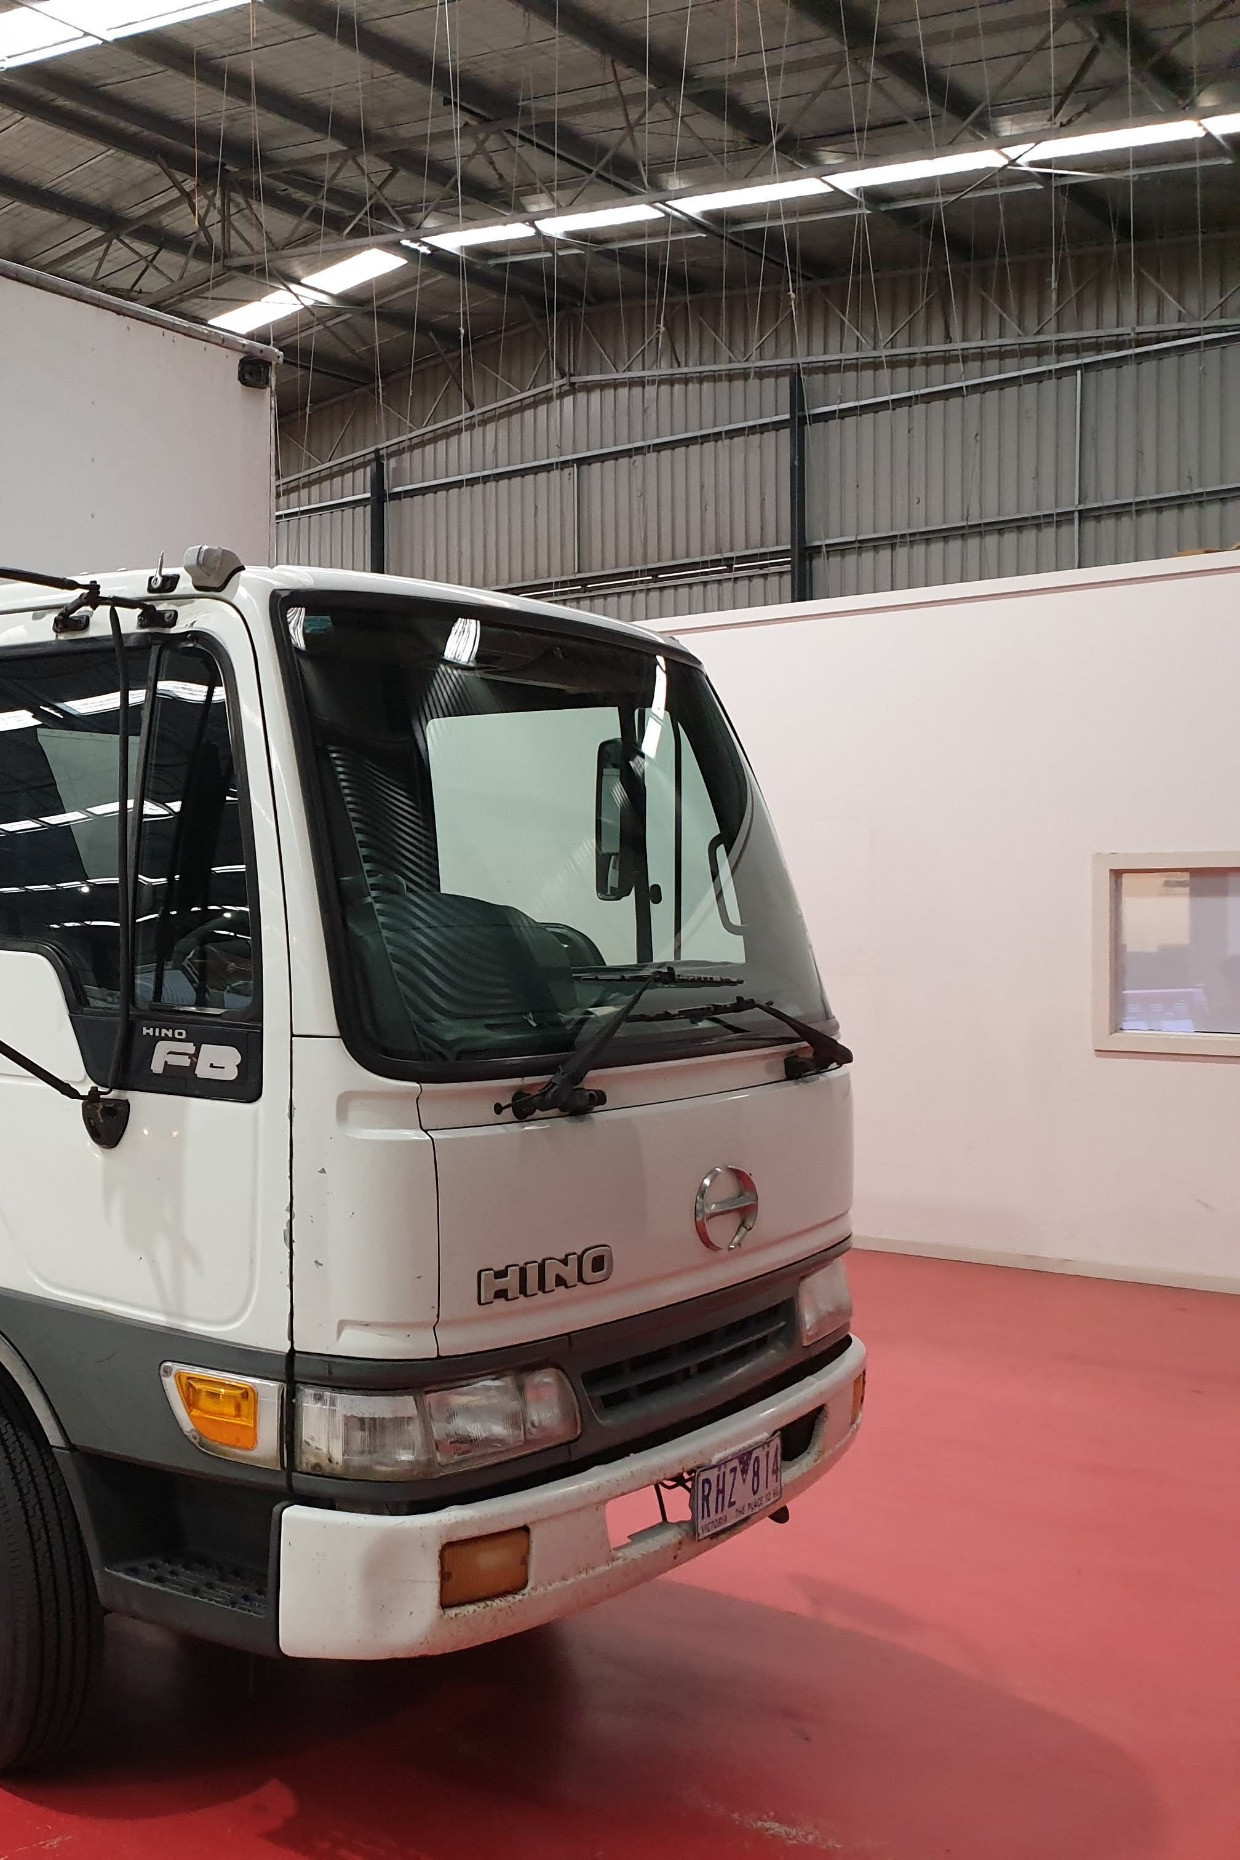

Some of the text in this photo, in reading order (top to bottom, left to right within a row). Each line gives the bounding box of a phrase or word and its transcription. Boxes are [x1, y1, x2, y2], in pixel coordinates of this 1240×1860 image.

[142, 1026, 187, 1039] HINO
[150, 1040, 242, 1081] FB
[477, 1243, 614, 1306] HINO
[701, 1443, 779, 1520] RHZ 814
